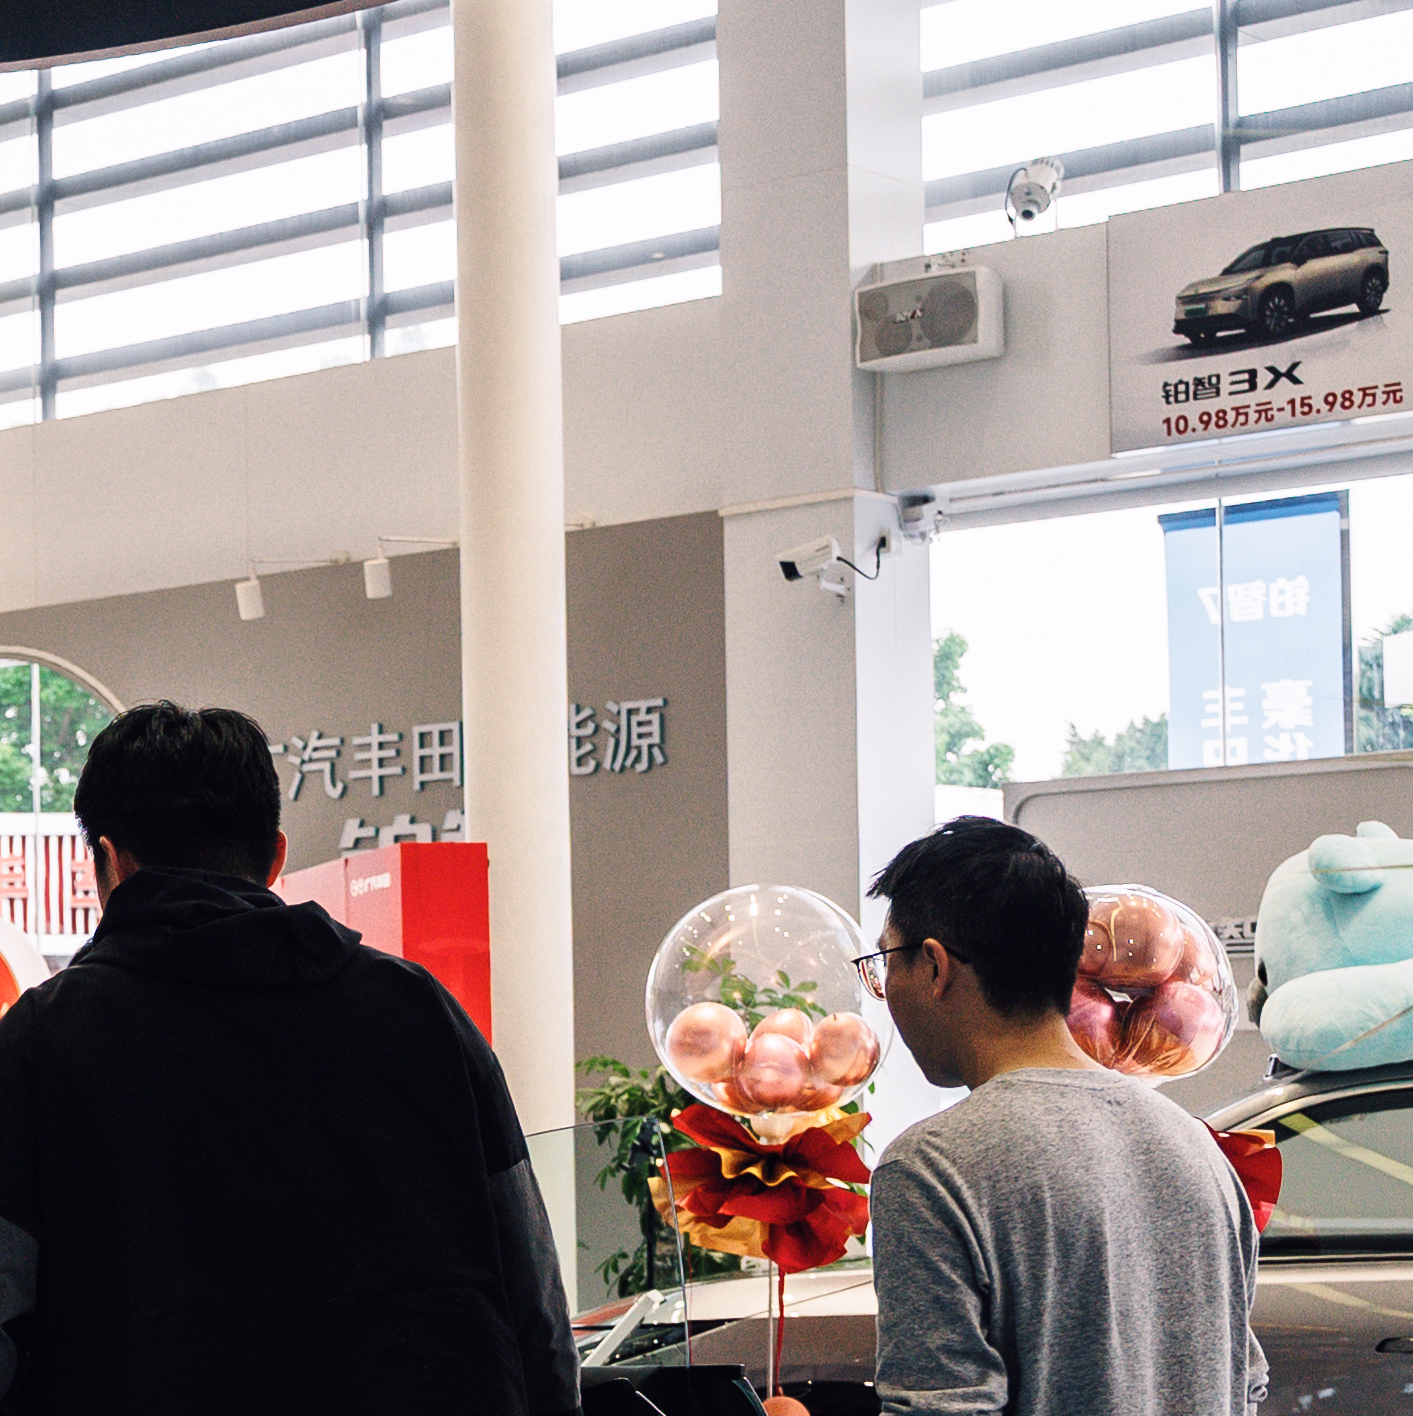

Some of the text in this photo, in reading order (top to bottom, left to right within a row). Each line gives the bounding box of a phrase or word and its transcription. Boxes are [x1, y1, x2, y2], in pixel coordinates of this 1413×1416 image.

[1161, 361, 1304, 405] 铂智3X
[1162, 382, 1404, 437] 10.98万元-15.98万元
